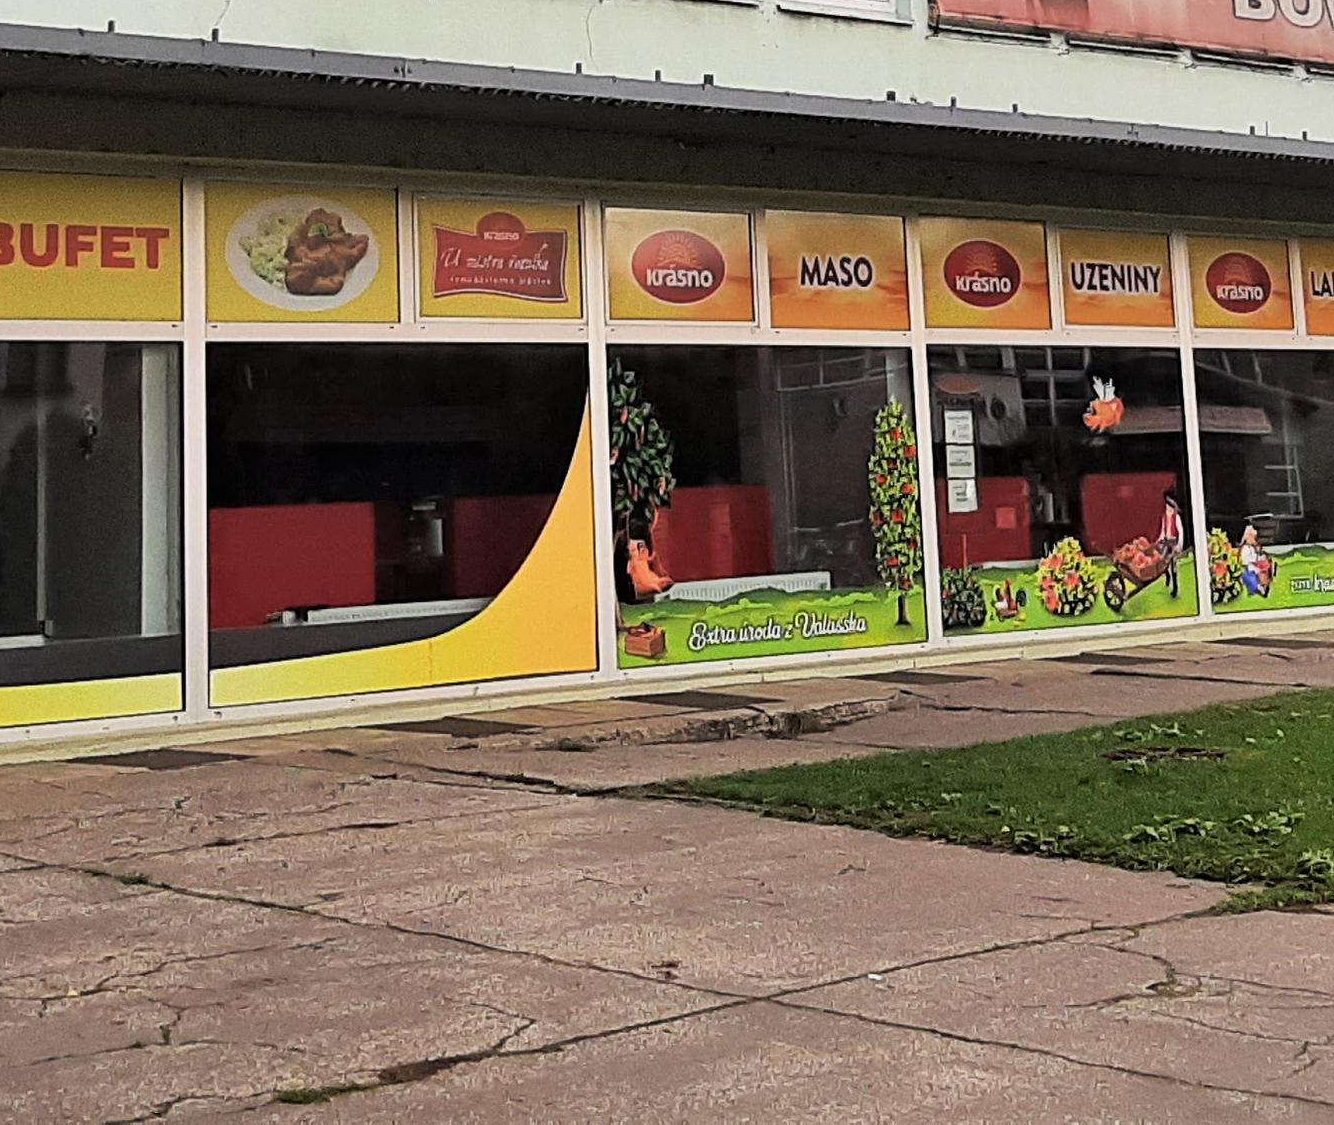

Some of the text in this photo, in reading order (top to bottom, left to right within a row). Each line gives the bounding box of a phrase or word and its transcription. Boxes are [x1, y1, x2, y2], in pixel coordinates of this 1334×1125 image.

[800, 256, 873, 288] MASO
[1070, 262, 1162, 294] UZENINY
[689, 622, 736, 651] Extra
[738, 618, 781, 643] úroda
